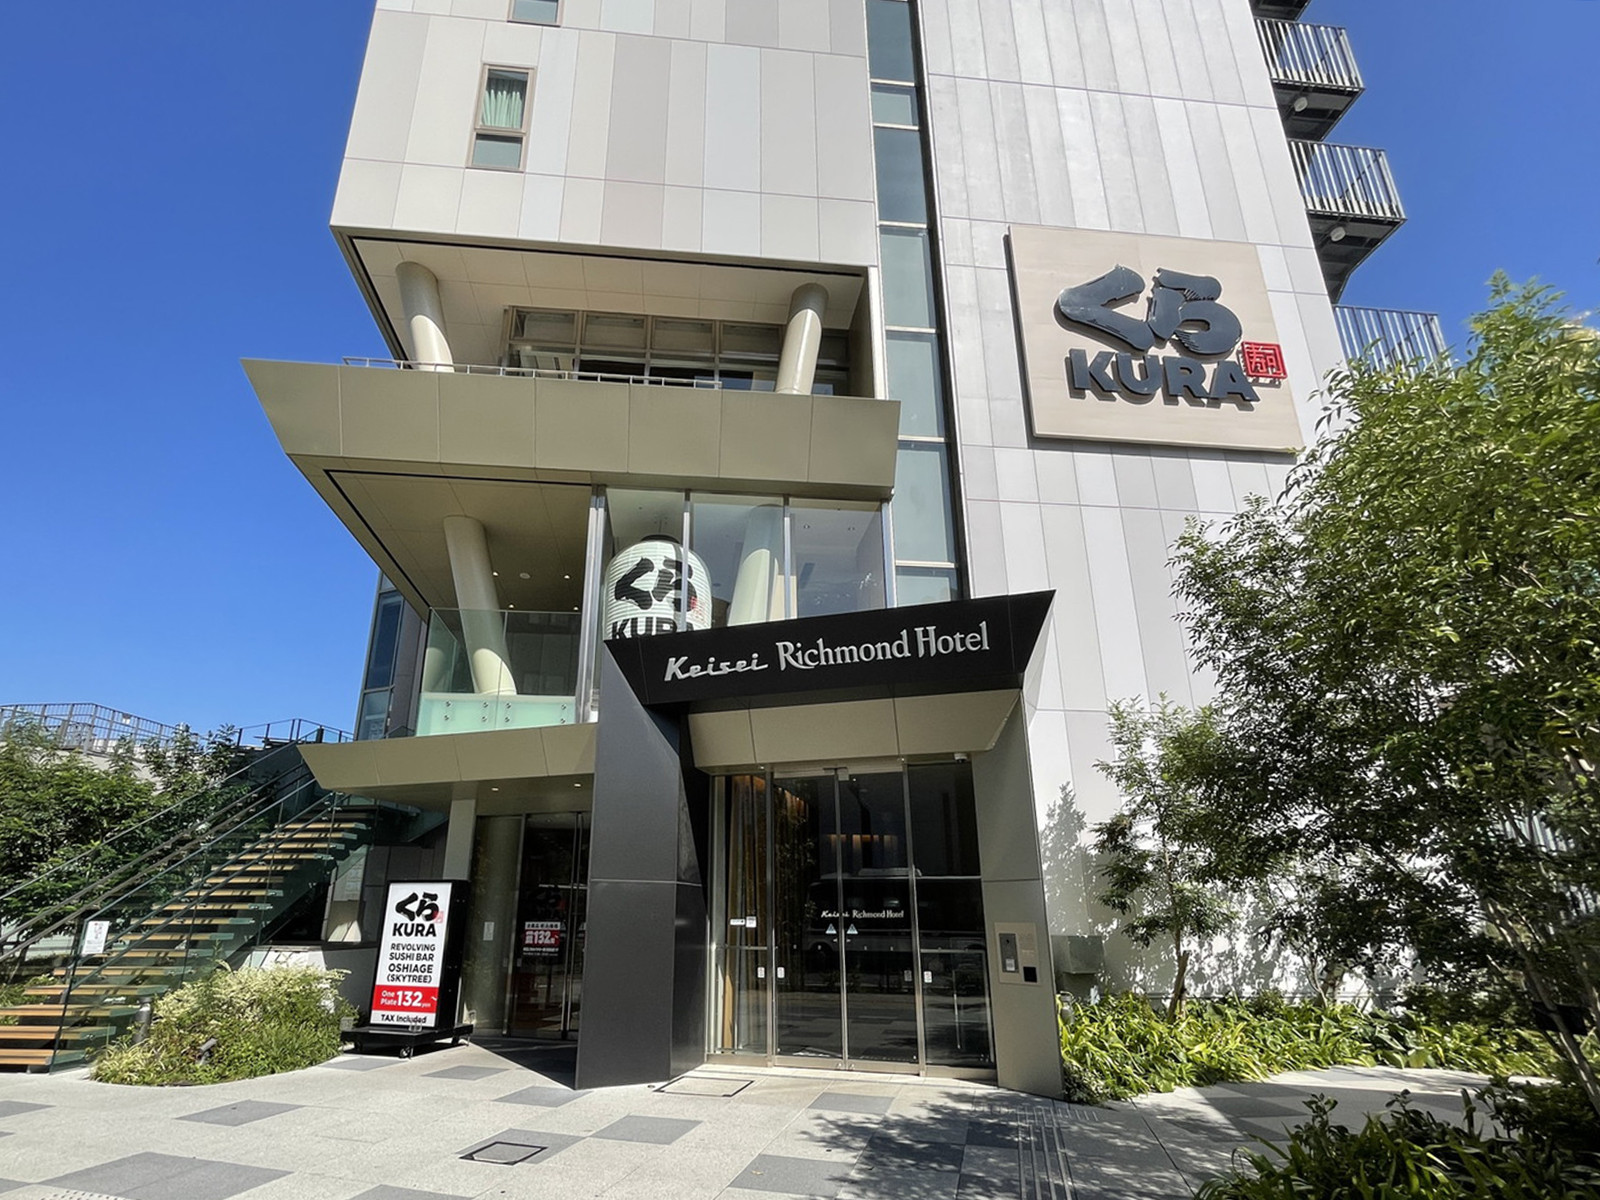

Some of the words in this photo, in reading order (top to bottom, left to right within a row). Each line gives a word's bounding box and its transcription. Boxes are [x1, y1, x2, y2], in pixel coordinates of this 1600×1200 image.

[1054, 264, 1242, 355] くら
[1068, 347, 1260, 402] KURA
[664, 653, 768, 682] Keisei
[775, 629, 911, 671] Richmond
[914, 621, 990, 658] Hotel
[395, 892, 439, 922] くら
[392, 923, 437, 937] KURA
[390, 943, 436, 952] REVOLVING
[389, 952, 415, 961] SUSHI
[416, 953, 434, 962] BAR
[388, 963, 434, 974] OSHIAGE
[386, 974, 432, 984] (SKYTREE)
[381, 990, 395, 998] One
[397, 991, 423, 1007] 132
[380, 998, 397, 1006] Plate
[381, 1014, 395, 1022] TAX
